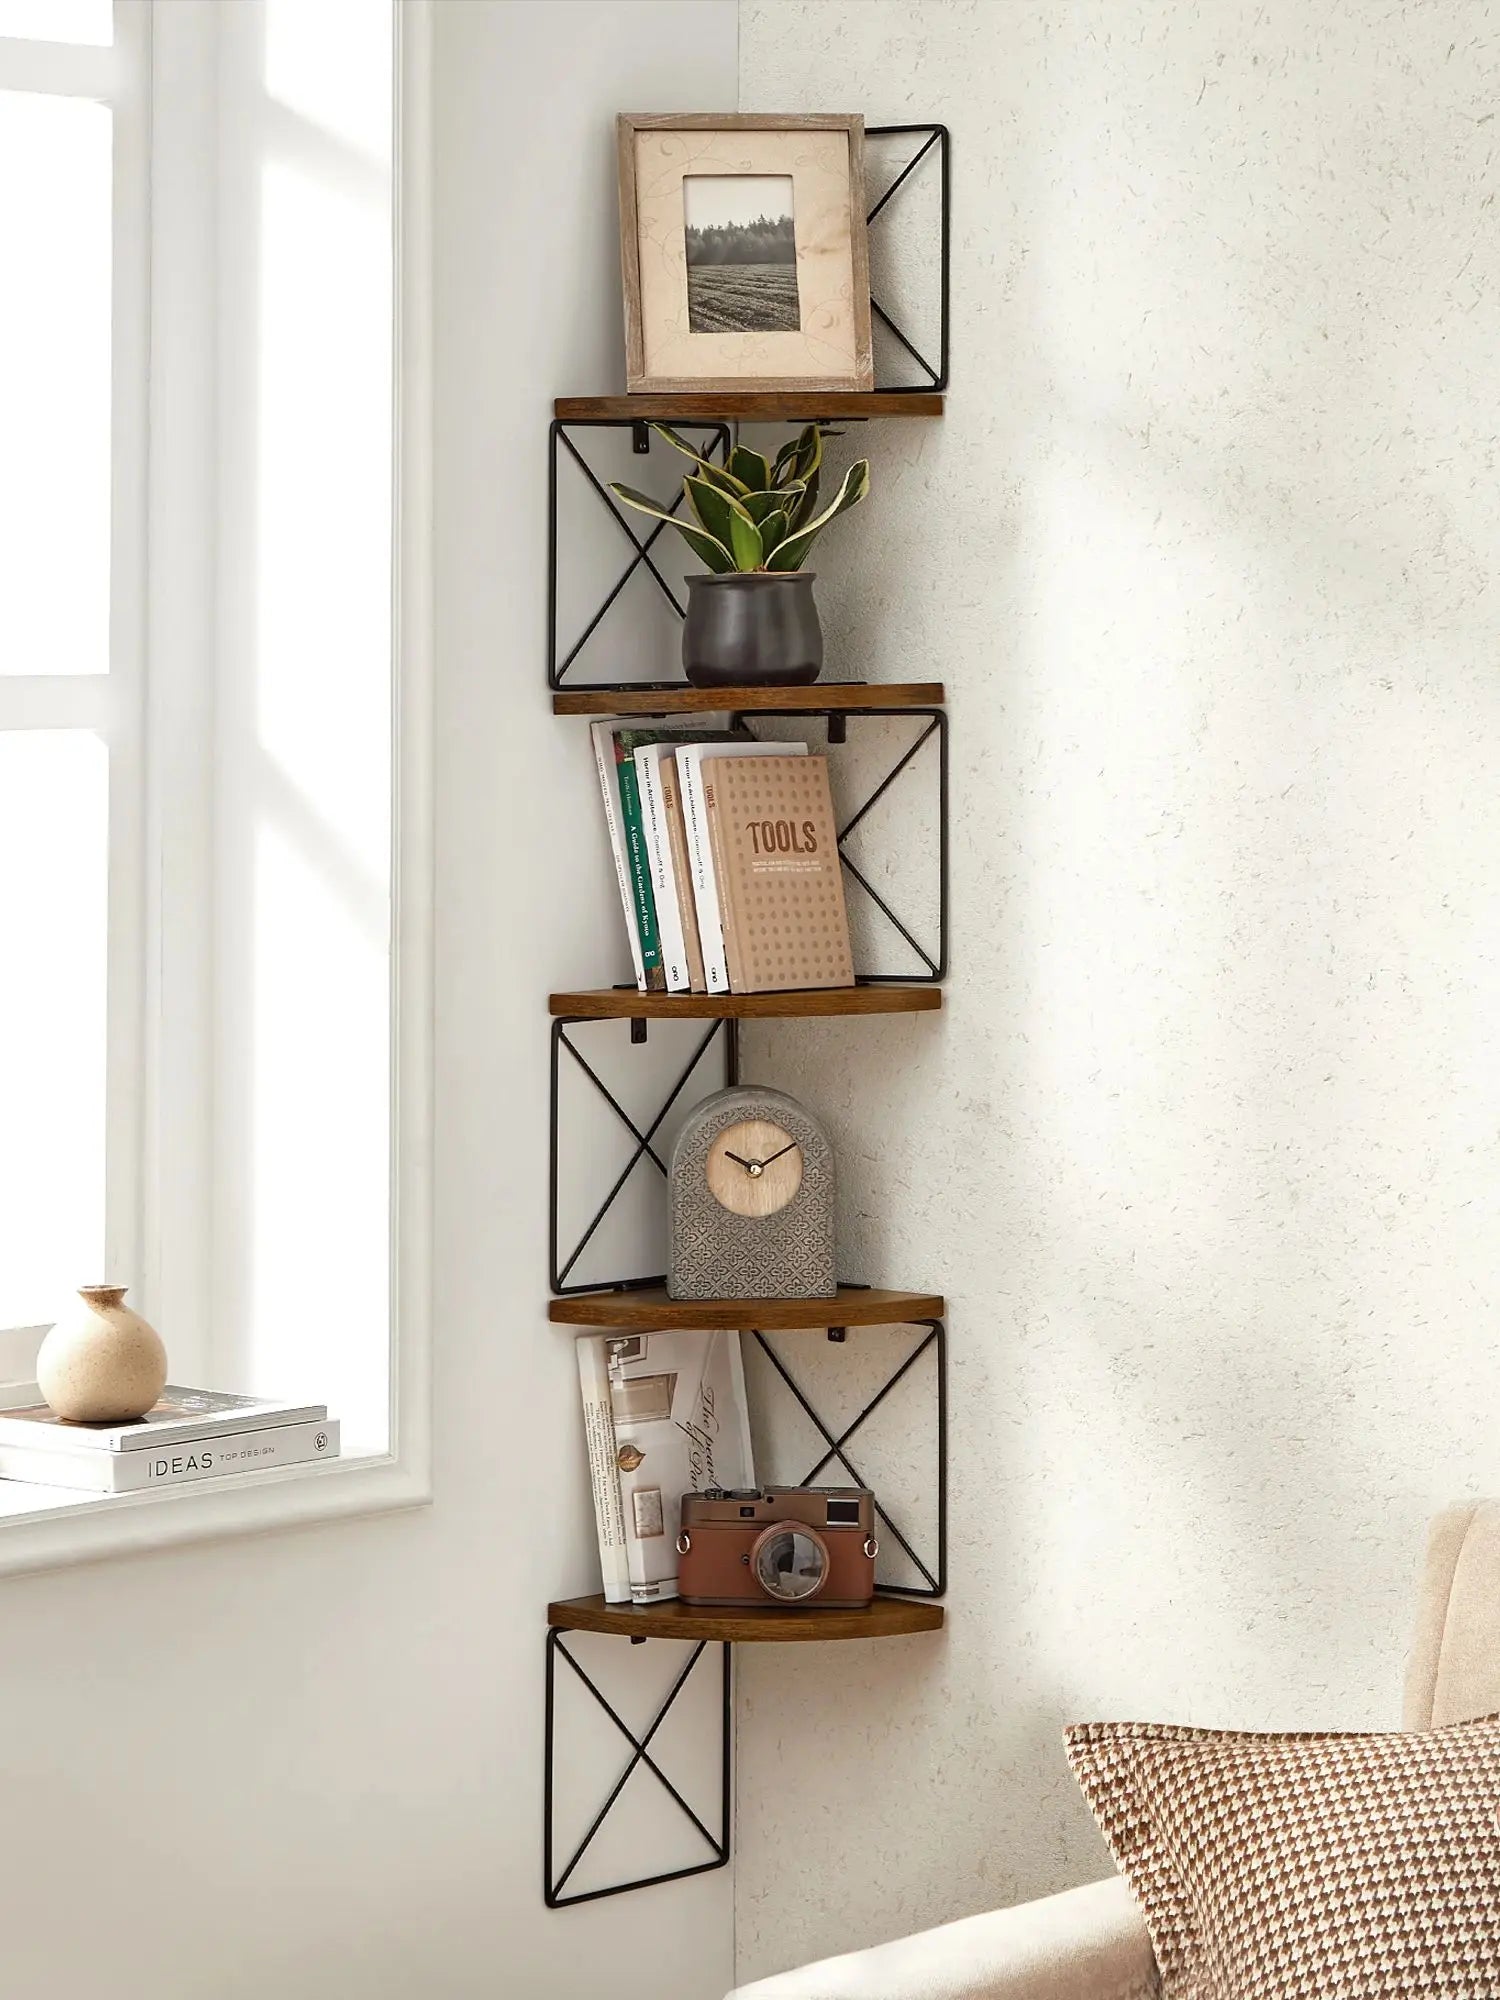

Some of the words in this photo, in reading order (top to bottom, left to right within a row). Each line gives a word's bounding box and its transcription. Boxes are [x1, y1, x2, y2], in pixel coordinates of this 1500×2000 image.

[664, 784, 673, 809] TOOLS
[705, 784, 715, 808] TOOLS
[631, 833, 640, 854] Guide
[745, 820, 818, 854] TOOLS
[634, 855, 640, 863] to
[641, 906, 649, 914] of
[702, 1386, 719, 1433] The
[148, 1452, 213, 1478] IDEAS
[219, 1453, 238, 1461] TOP
[240, 1447, 275, 1460] DESIGN
